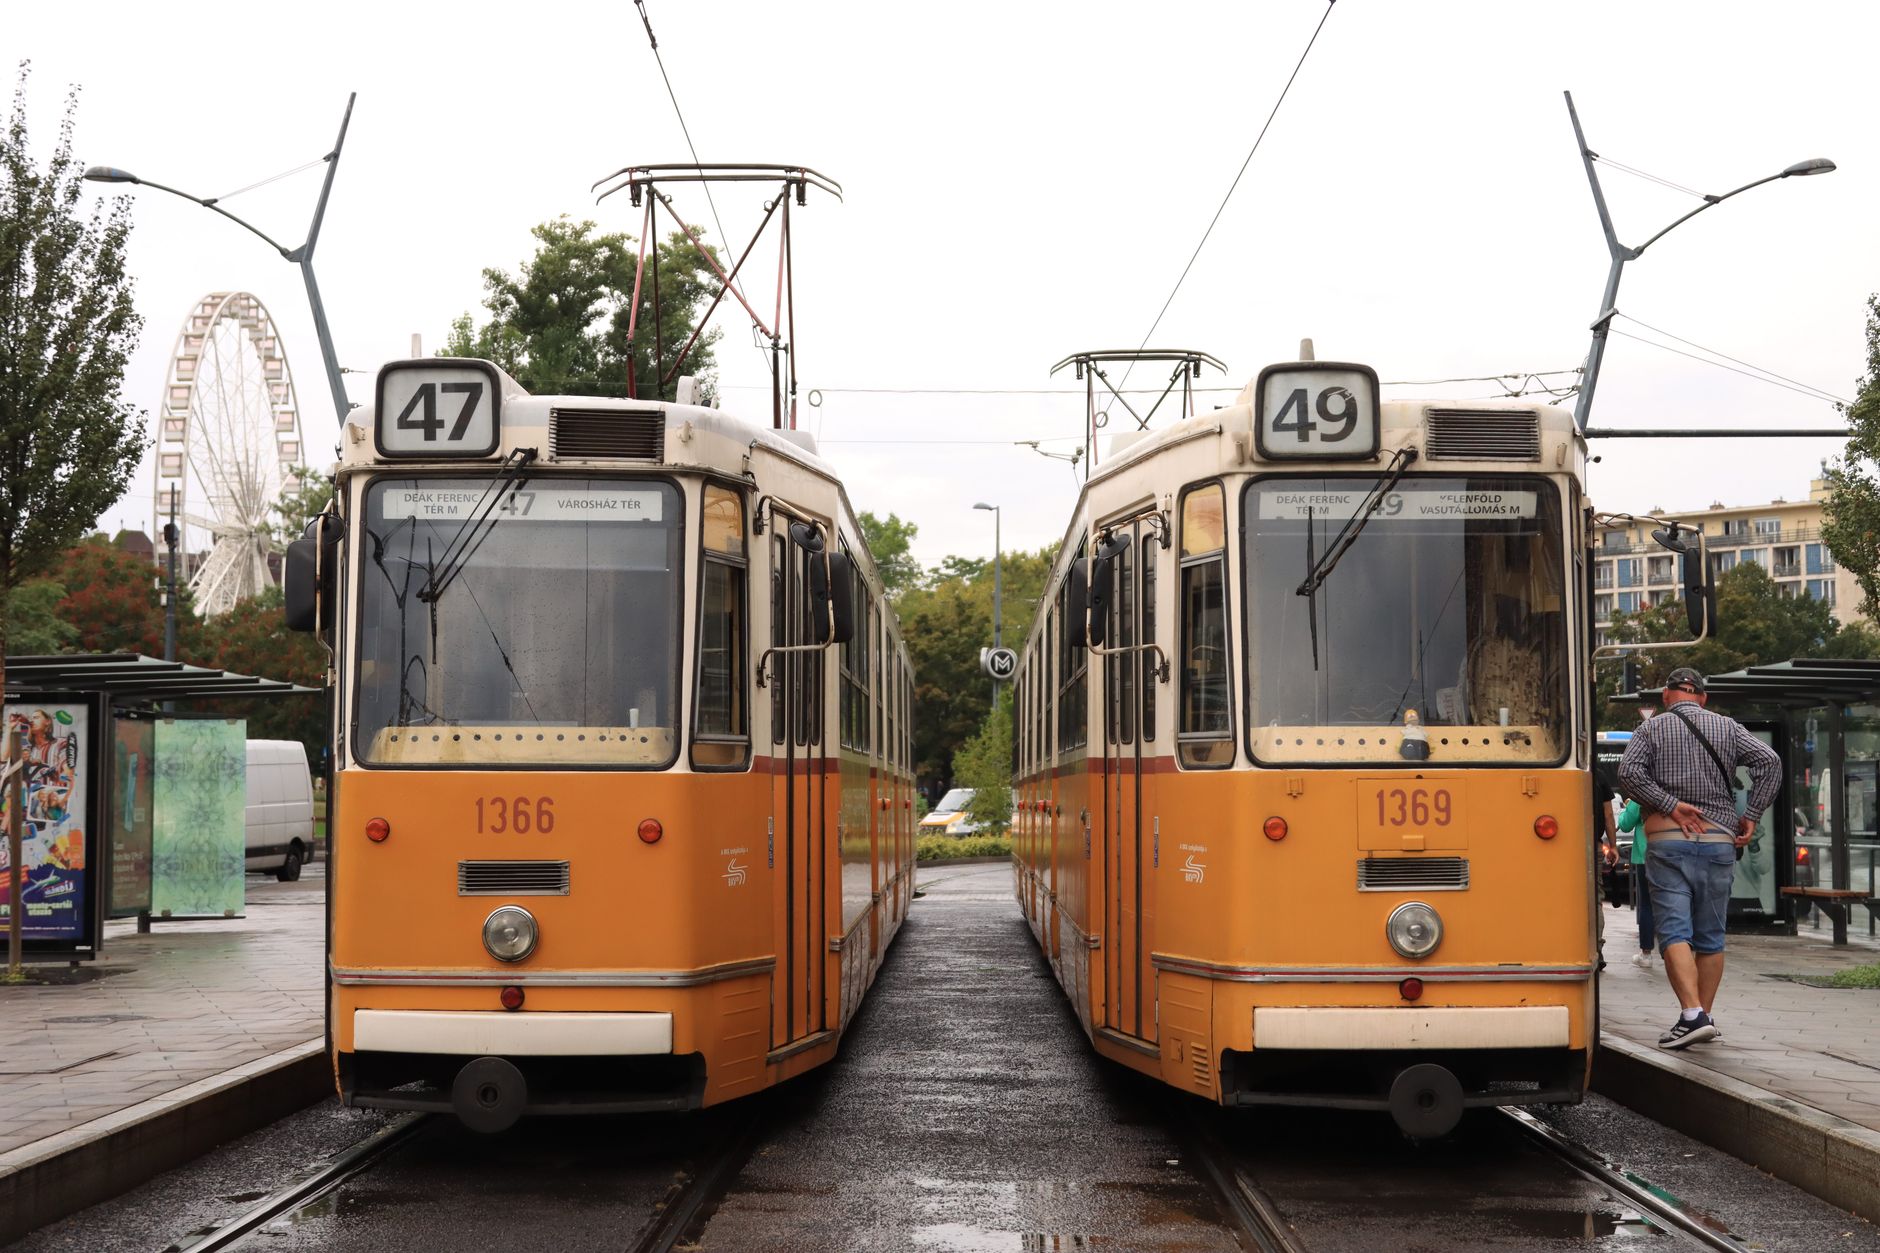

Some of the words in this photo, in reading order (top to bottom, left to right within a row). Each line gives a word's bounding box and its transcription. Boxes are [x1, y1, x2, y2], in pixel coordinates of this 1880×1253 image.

[397, 382, 483, 441] 47
[1272, 386, 1358, 442] 49
[404, 492, 433, 503] DEÁK
[437, 493, 478, 503] FERENC
[501, 492, 536, 516] 47
[558, 498, 618, 509] VÁROSHÁZ
[620, 498, 641, 509] TÉR
[1276, 494, 1306, 504] DEÁK
[1309, 495, 1350, 504] FERENC
[424, 503, 444, 515] TÉR
[447, 505, 458, 515] M
[1296, 505, 1316, 514] TÉR
[1319, 506, 1330, 514] M
[1420, 504, 1506, 514] VASUTÁLLOMÁS
[1510, 505, 1520, 514] M
[994, 654, 1011, 671] M
[1376, 789, 1451, 826] 1369
[475, 796, 555, 834] 1366
